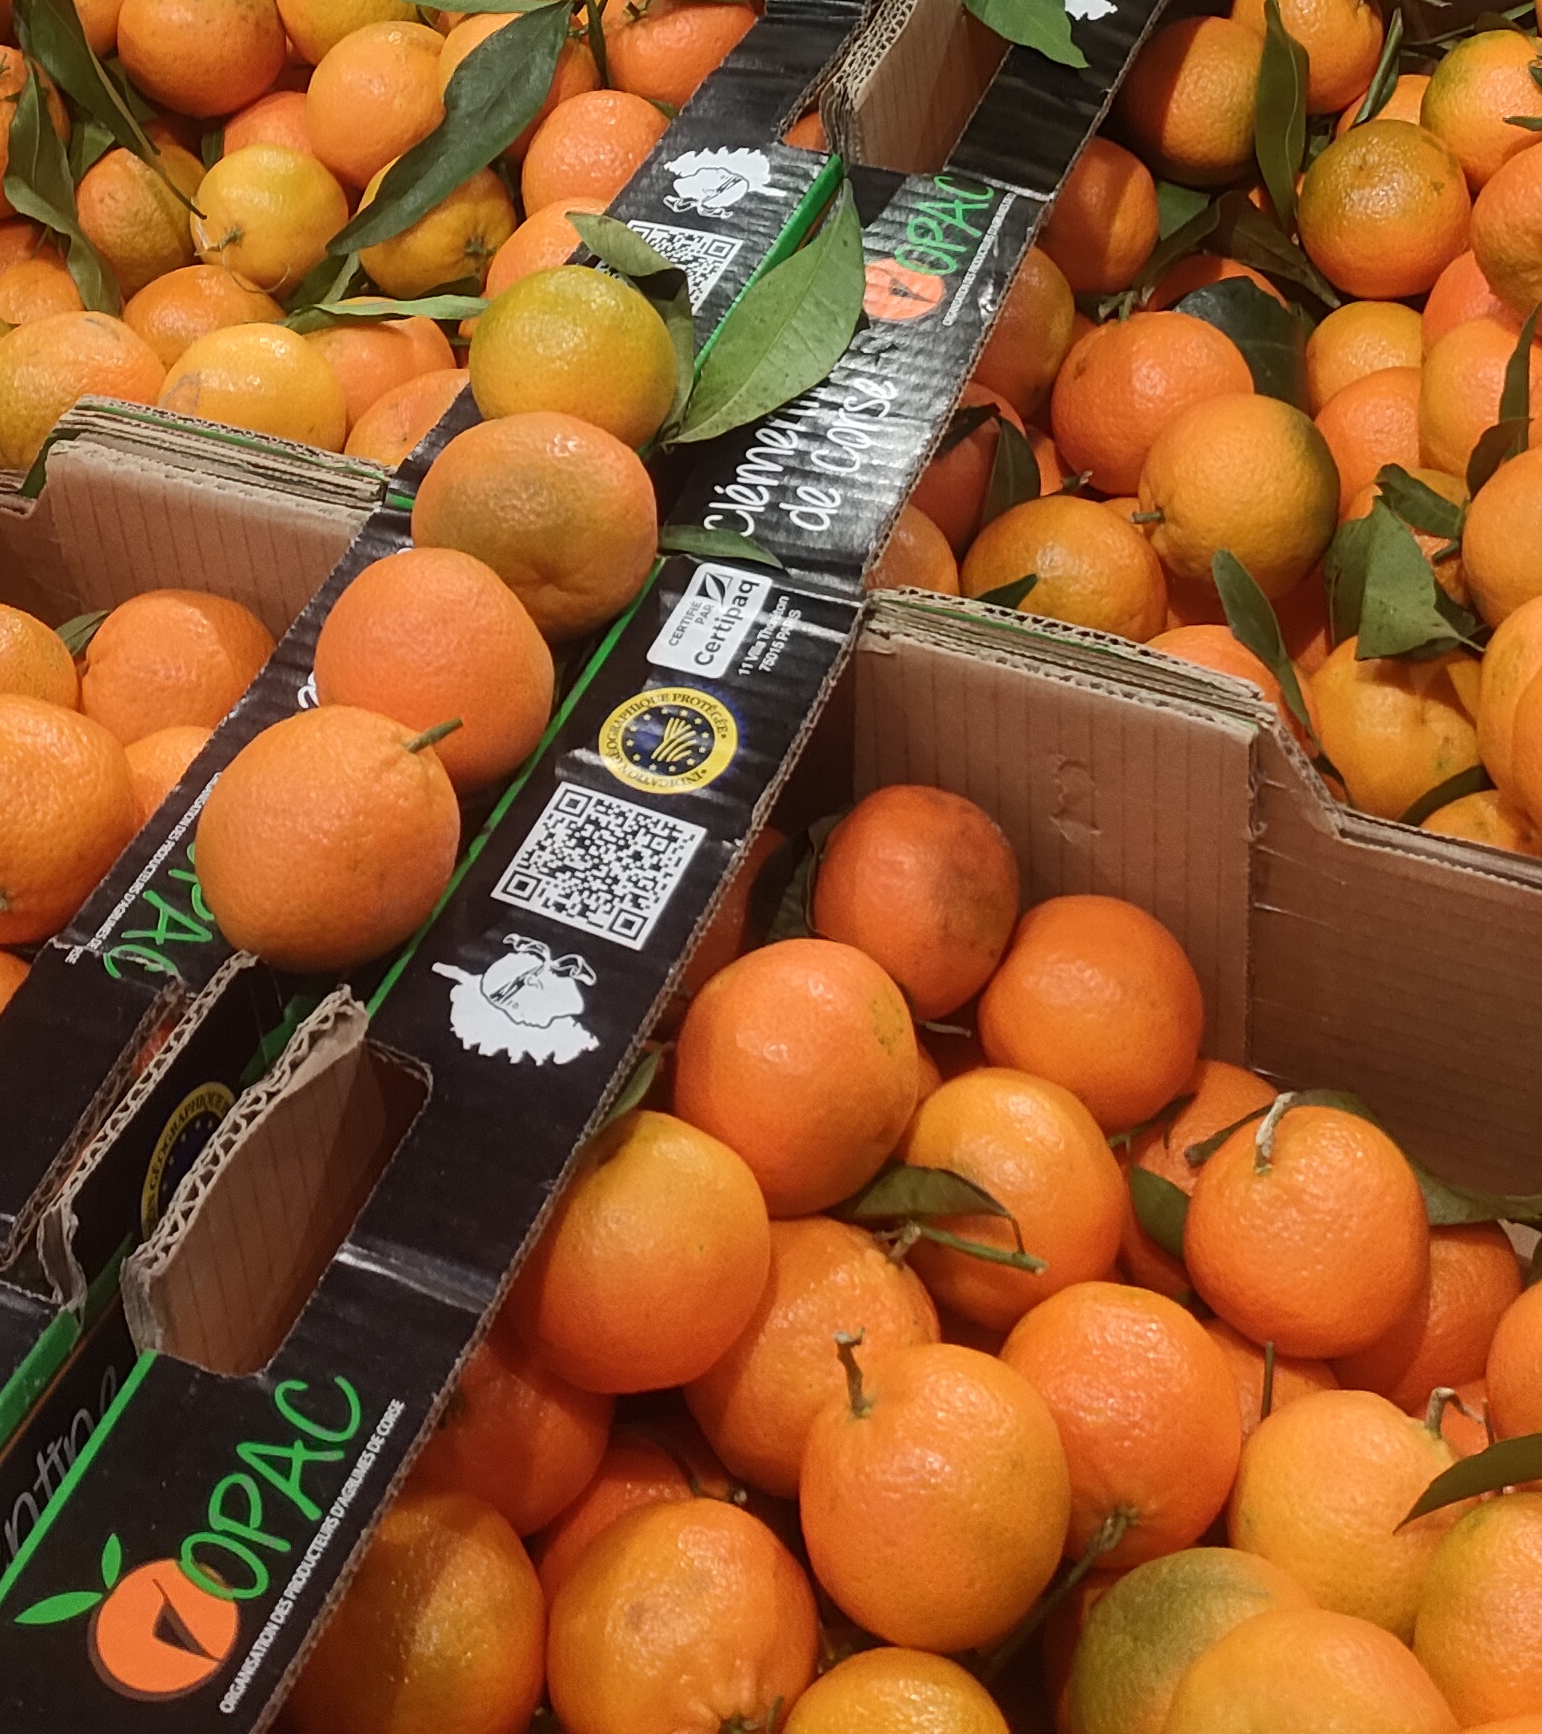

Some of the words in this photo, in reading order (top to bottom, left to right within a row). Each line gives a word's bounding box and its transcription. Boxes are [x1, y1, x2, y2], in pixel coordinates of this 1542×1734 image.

[894, 175, 995, 276] OPAC
[779, 486, 841, 531] de
[811, 378, 899, 473] Corse
[694, 579, 759, 666] Certipaq
[695, 604, 714, 625] PAR
[738, 664, 753, 676] 11
[758, 642, 785, 672] 75015
[672, 693, 728, 733] PROTÉGÉE
[168, 823, 187, 841] DES
[129, 839, 175, 895] PRODUCTEURS
[180, 1375, 361, 1600] OPAC
[219, 1622, 281, 1714] ORGANISATION
[270, 1597, 293, 1625] DES
[283, 1515, 341, 1602] PRODUCTEURS
[329, 1449, 376, 1518] D'AGRUMES
[366, 1433, 386, 1454] DE
[376, 1398, 406, 1436] CORSE
